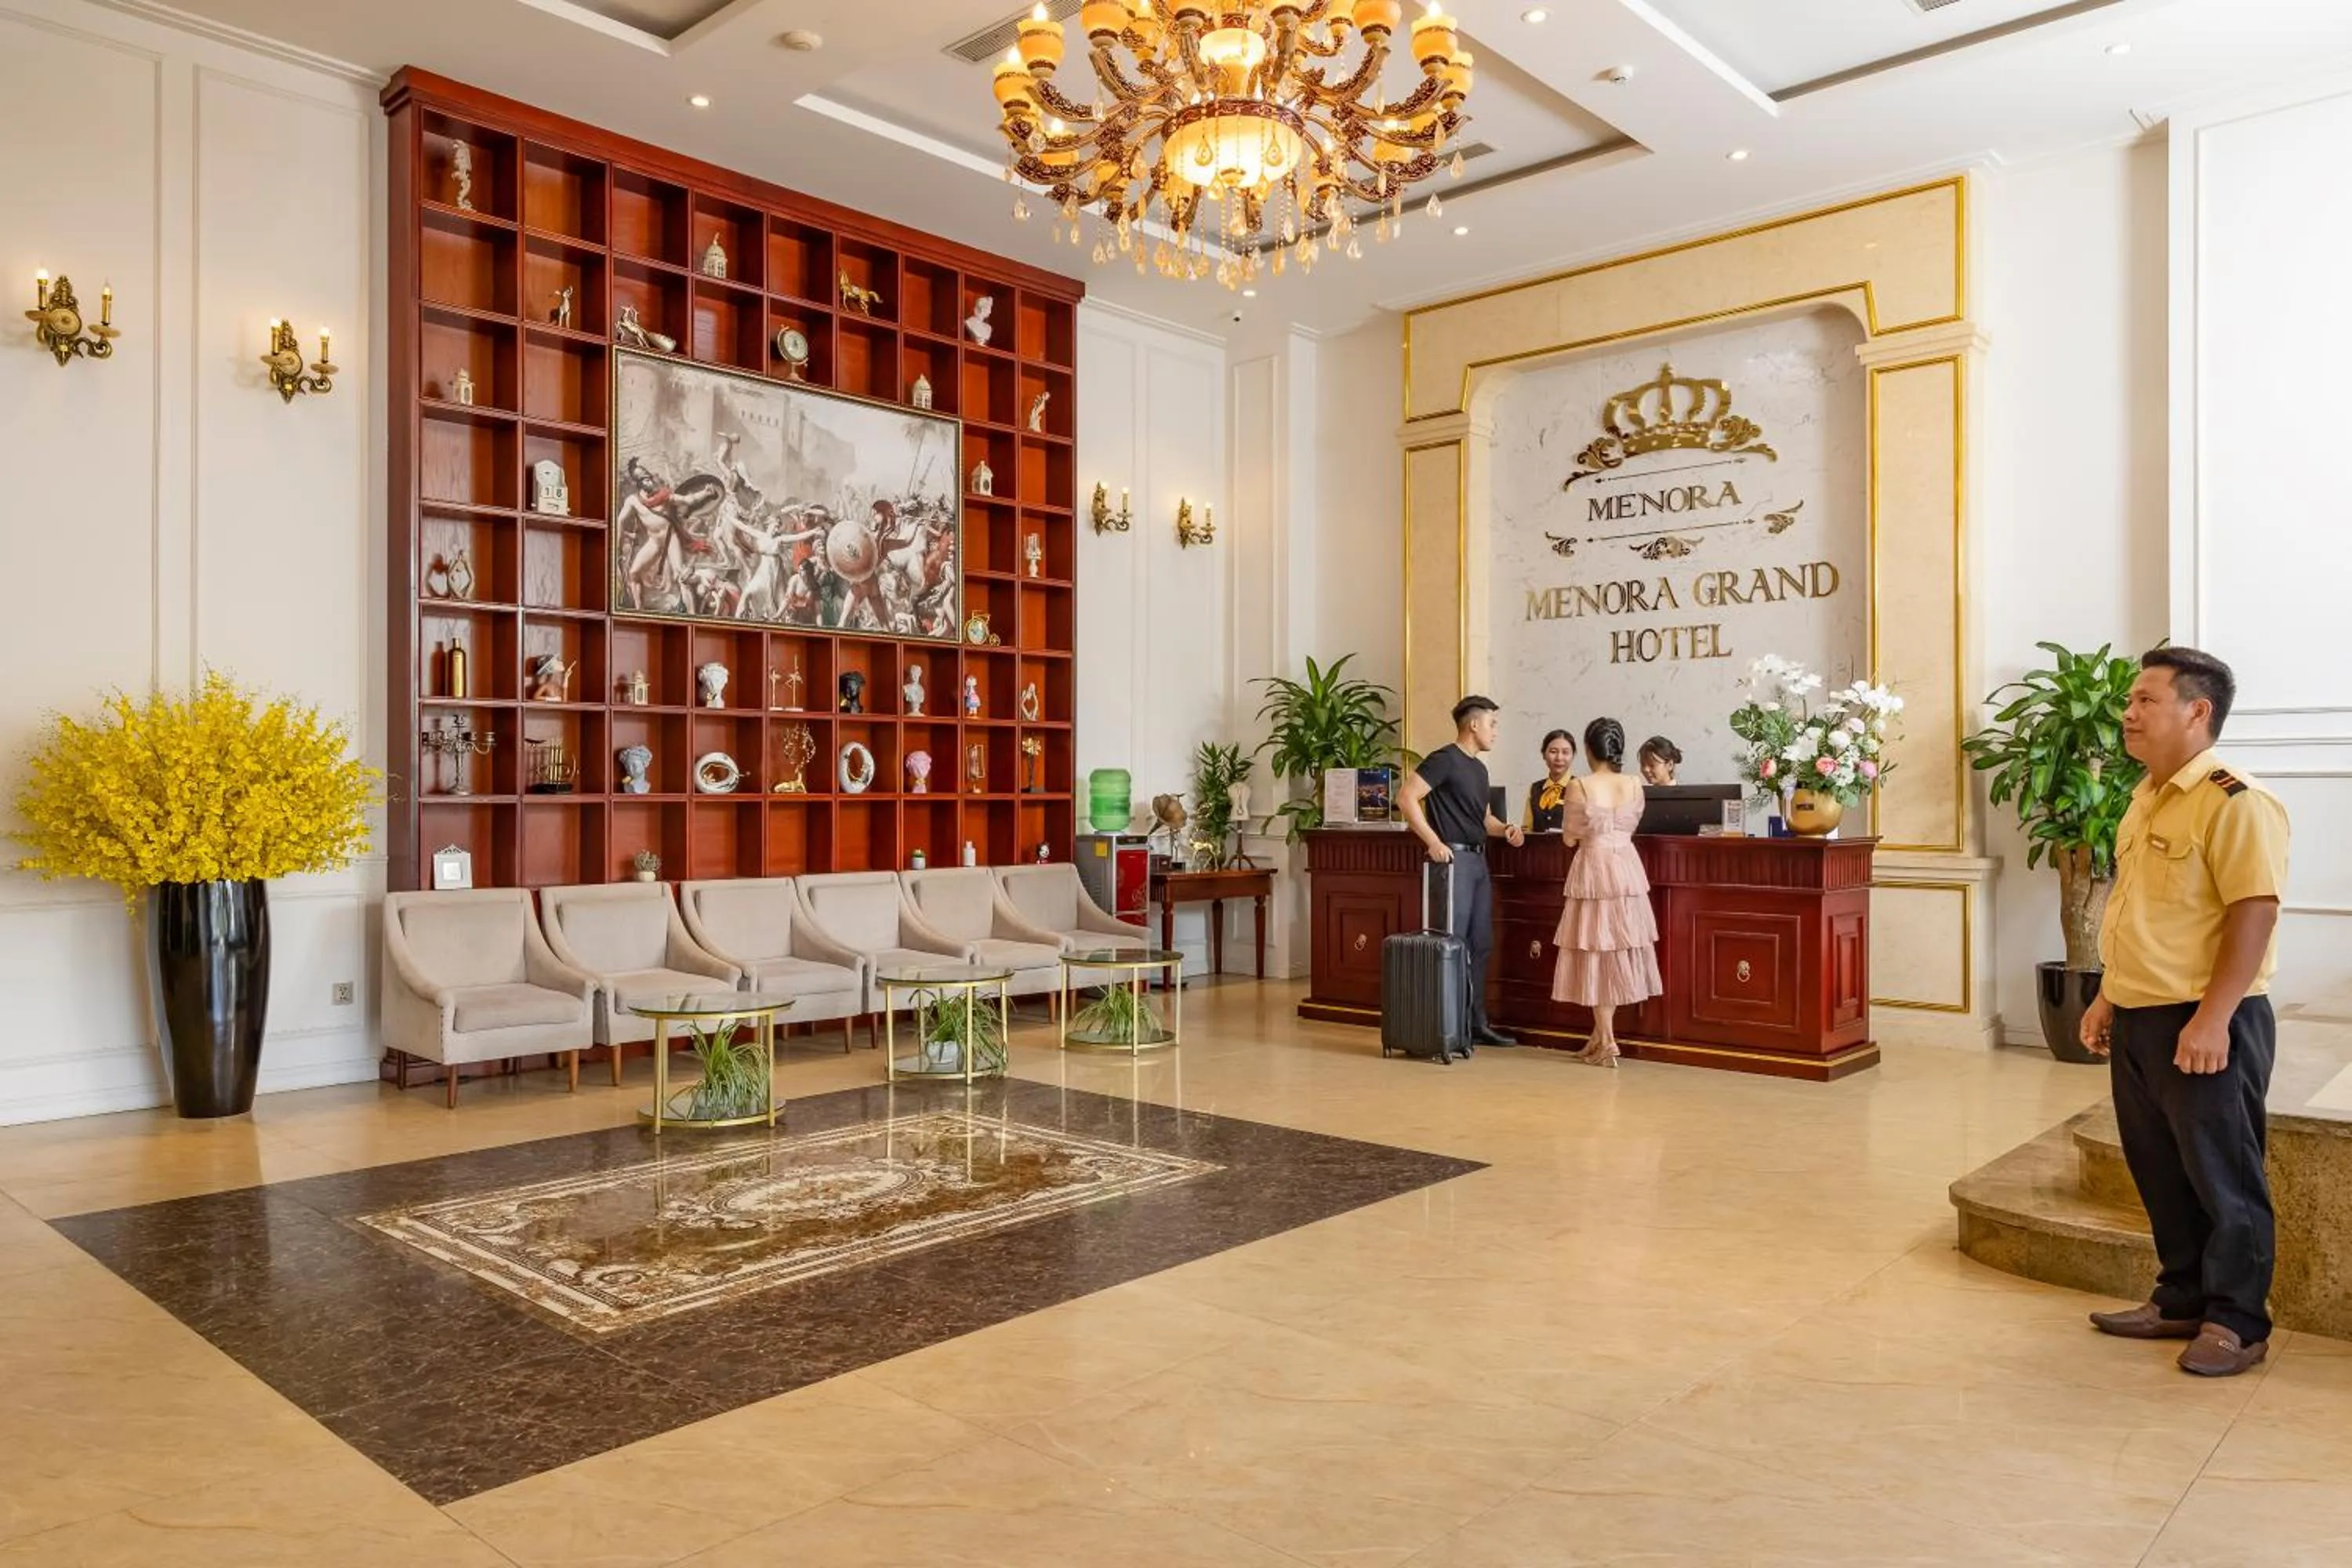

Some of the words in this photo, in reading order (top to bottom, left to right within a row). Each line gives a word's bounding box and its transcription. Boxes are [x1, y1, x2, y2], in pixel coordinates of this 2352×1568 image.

[1588, 481, 1742, 521] MENORA
[1525, 577, 1679, 621] MENORA
[1693, 561, 1840, 607] GRAND
[1610, 624, 1733, 663] HOTEL
